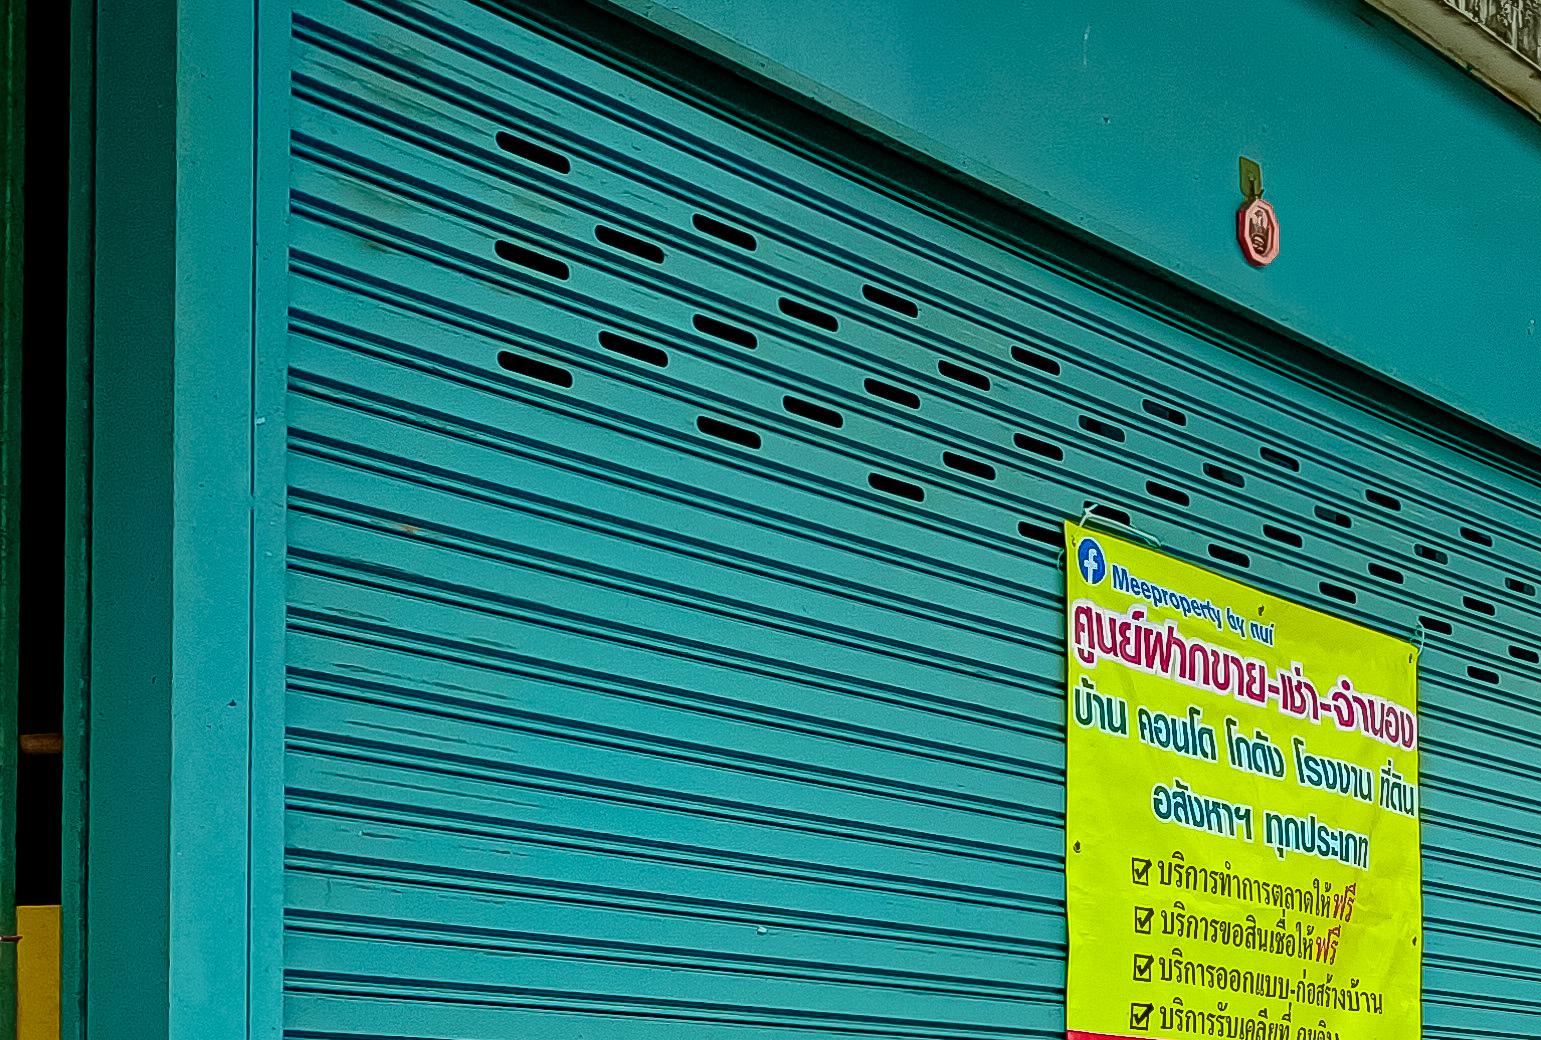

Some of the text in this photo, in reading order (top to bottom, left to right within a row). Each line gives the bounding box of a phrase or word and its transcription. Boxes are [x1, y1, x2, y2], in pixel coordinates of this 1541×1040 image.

[1112, 565, 1222, 629] Meeproperty
[1227, 608, 1246, 639] by
[1250, 621, 1275, 645] nui
[1074, 604, 1415, 749] ศูนย์ฝากขาย-เช่า-จำนอง
[1074, 678, 1416, 817] บ้าน คอนโด โกดัง โรงงาน ที่ดิน
[1152, 779, 1370, 871] อสังหาฯ ทุกประเภท
